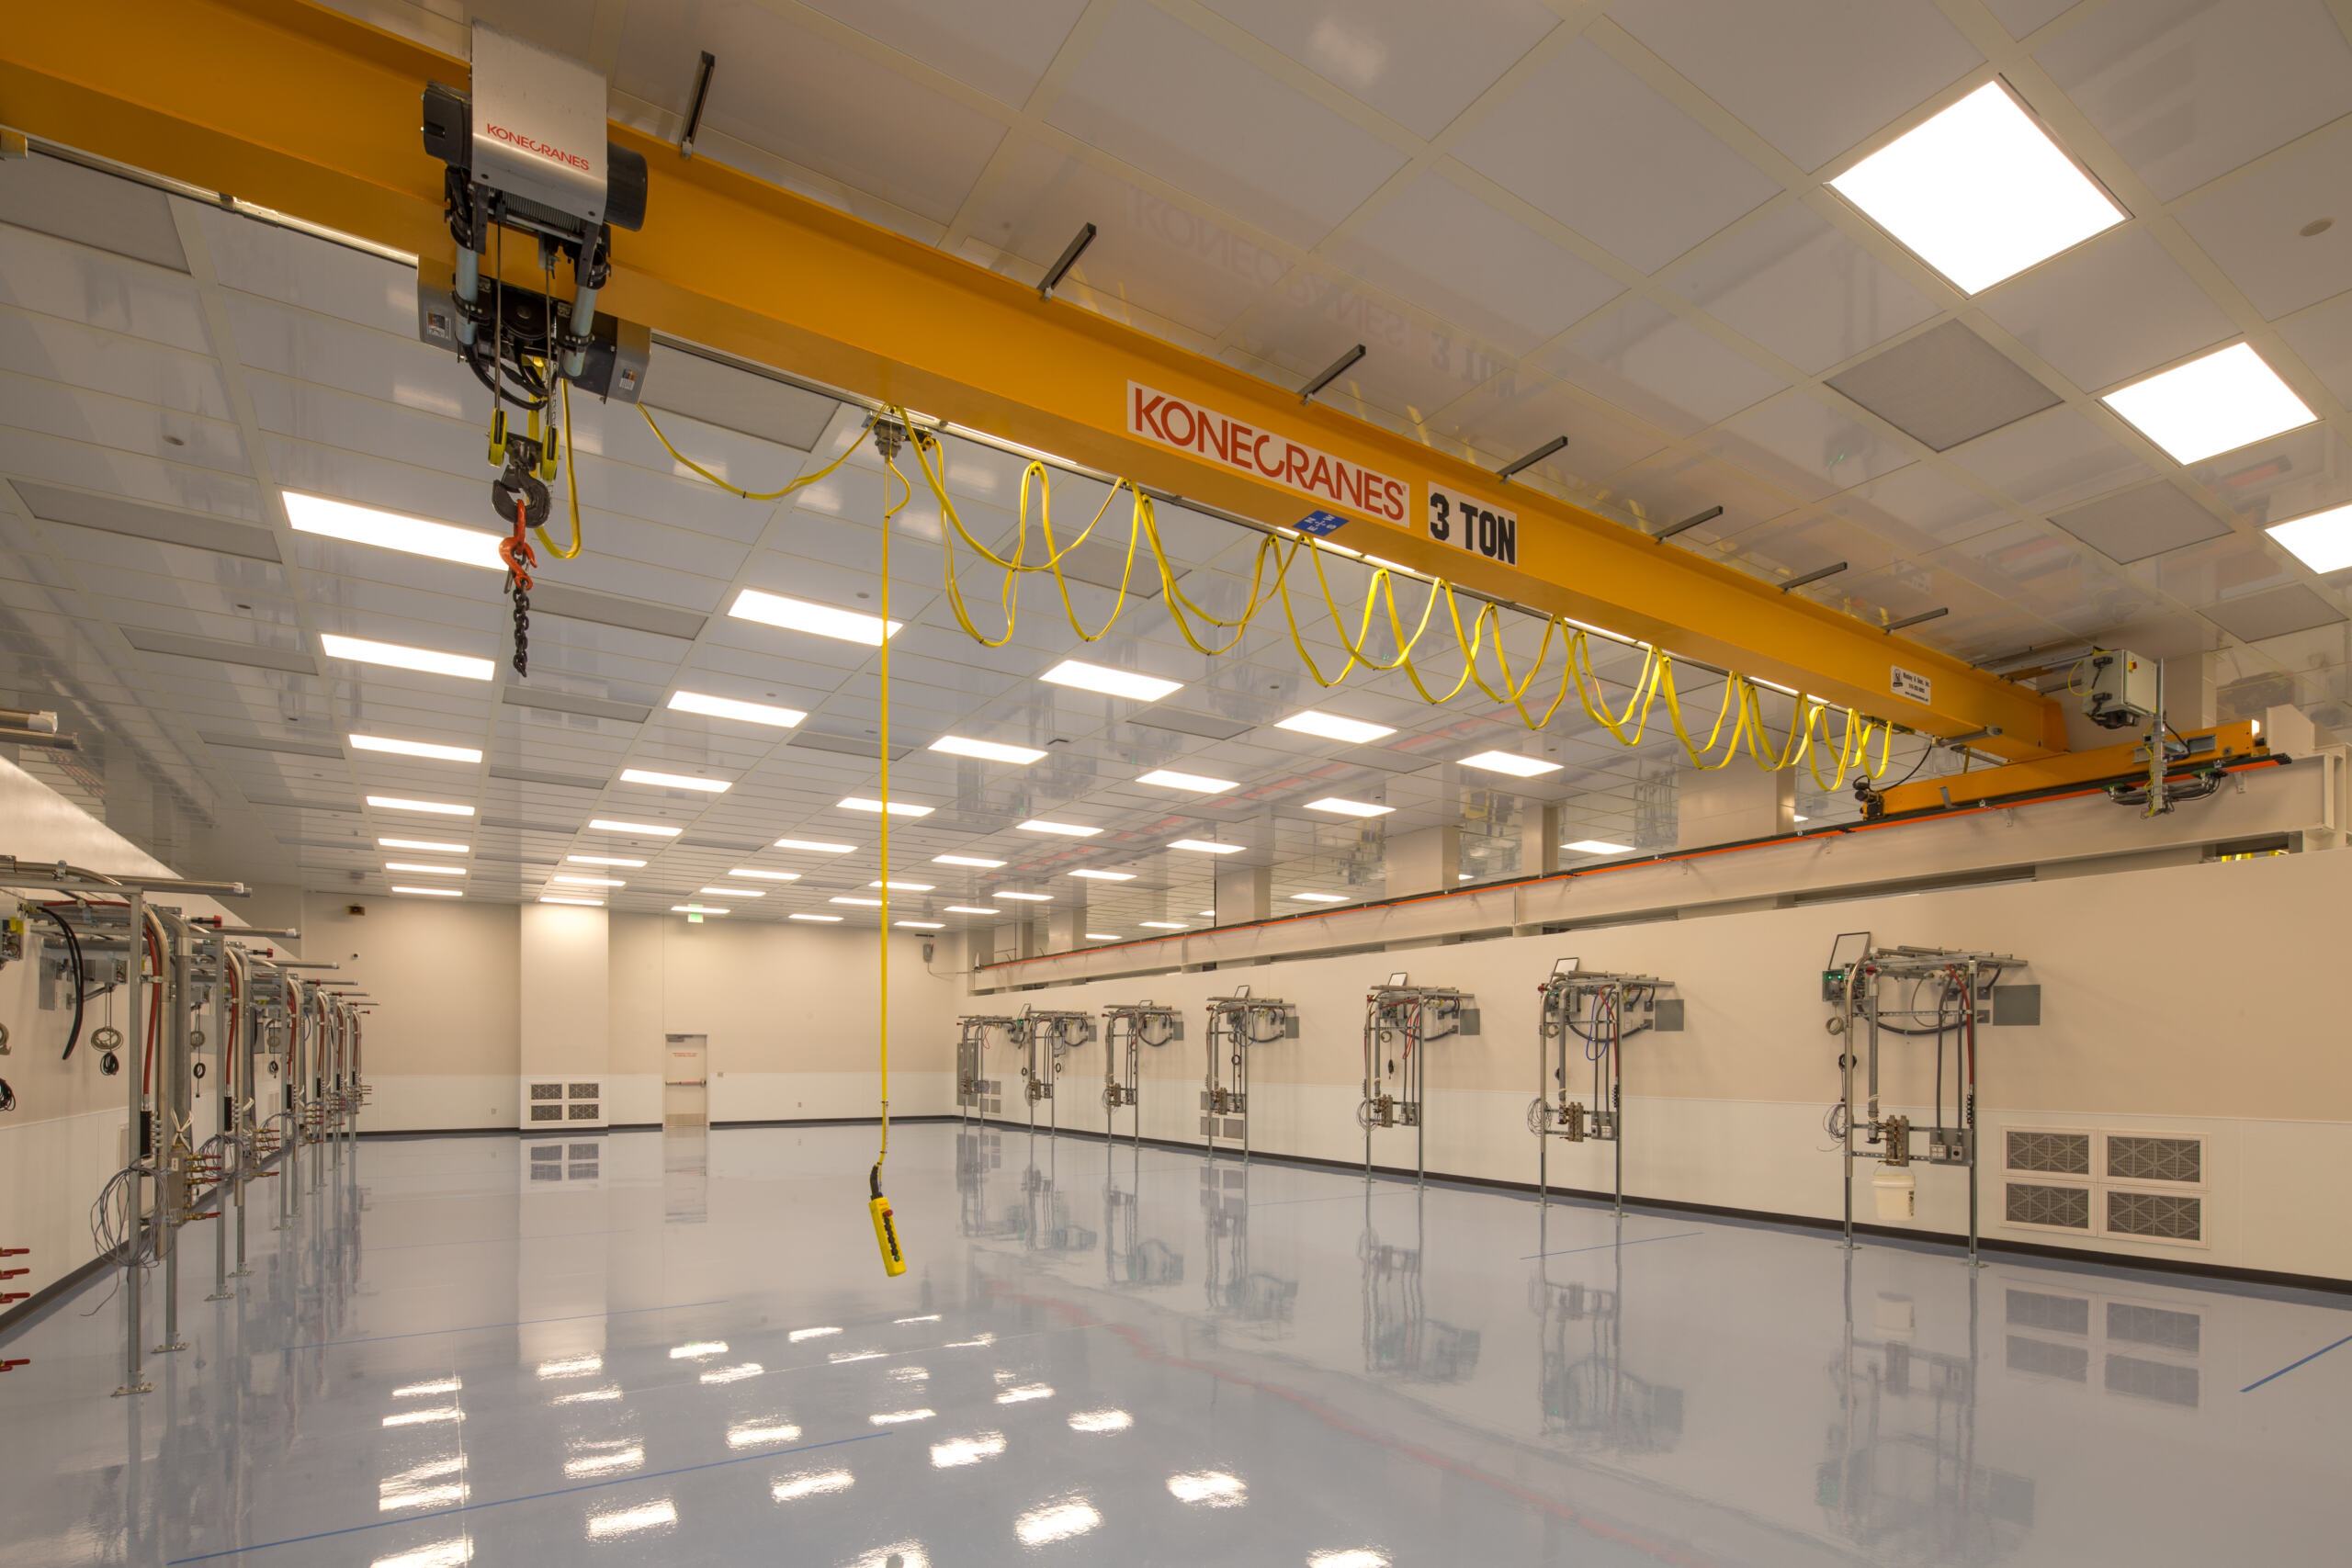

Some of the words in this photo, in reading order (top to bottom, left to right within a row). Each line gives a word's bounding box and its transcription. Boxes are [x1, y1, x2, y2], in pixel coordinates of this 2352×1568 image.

[487, 123, 590, 171] KONECRANES
[1135, 387, 1405, 521] KONECRANES
[1430, 491, 1450, 541] 3
[1459, 502, 1516, 565] TON
